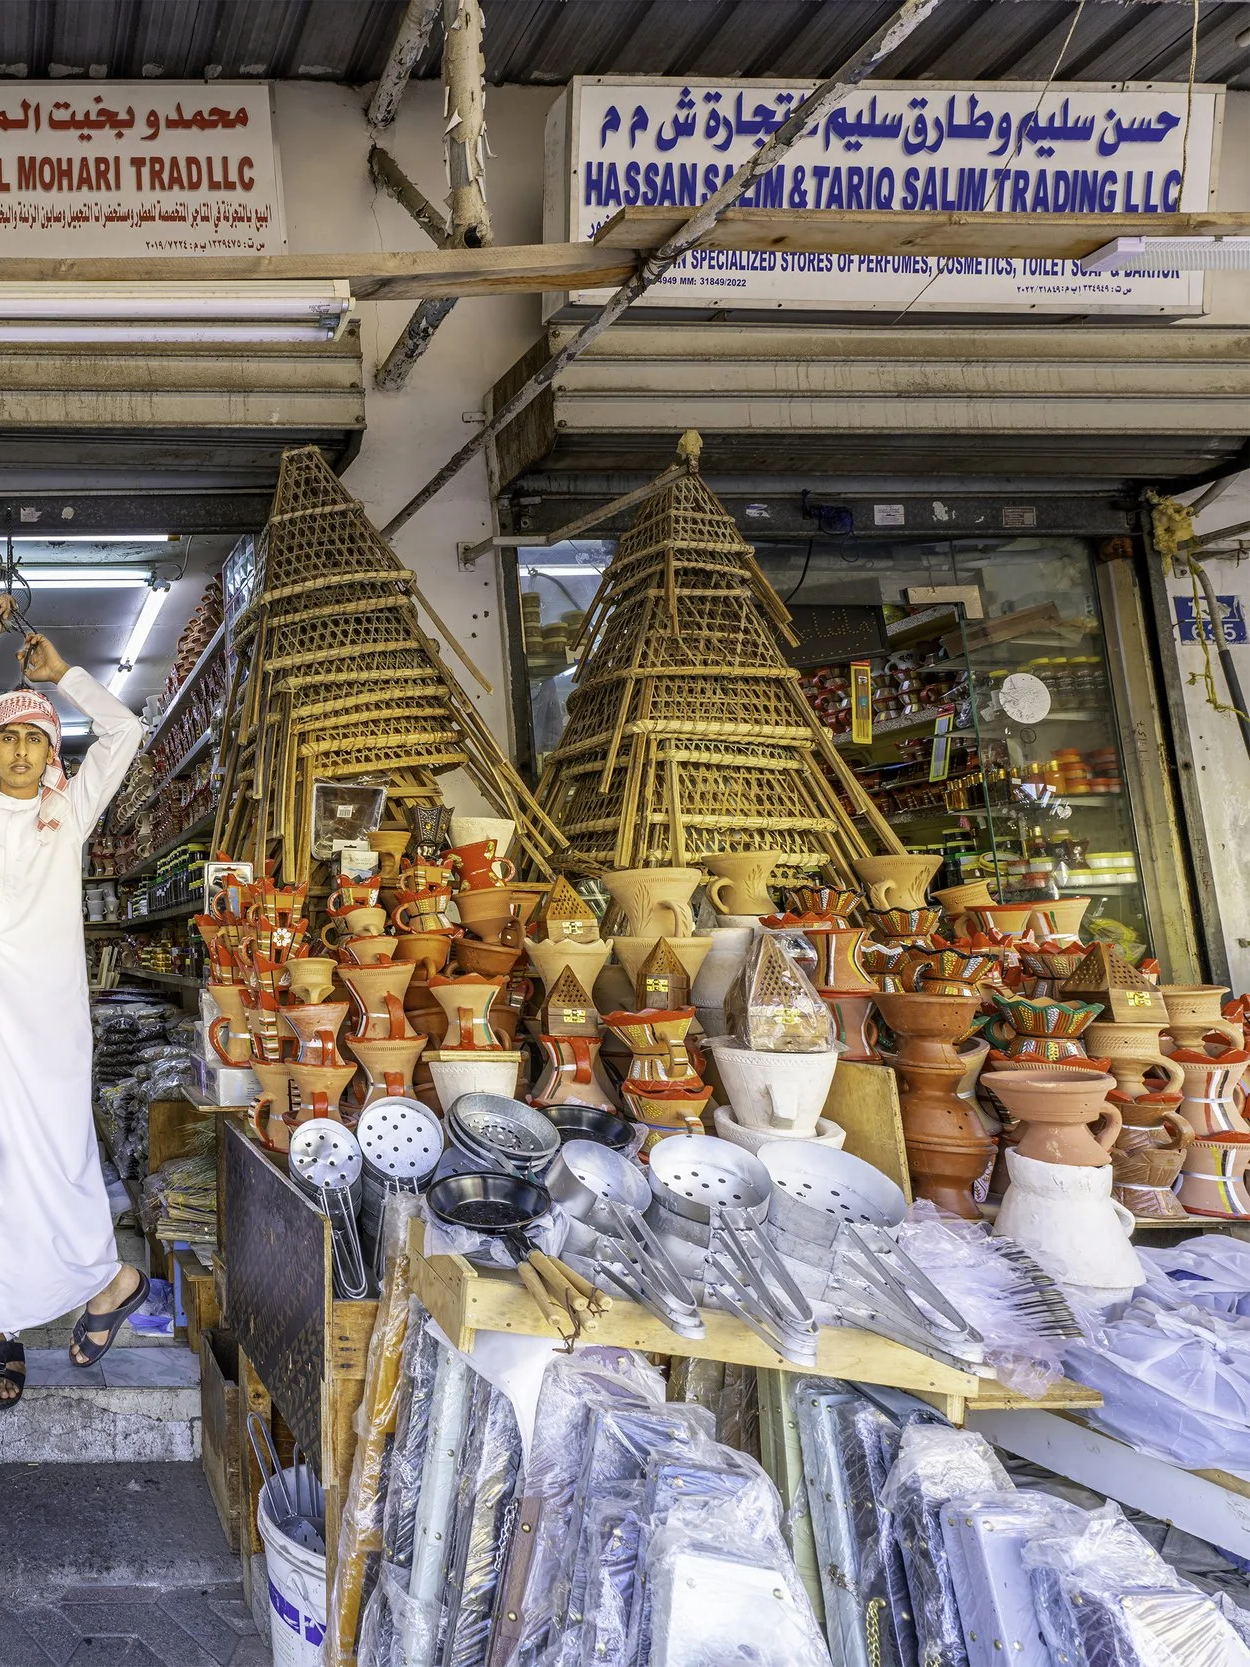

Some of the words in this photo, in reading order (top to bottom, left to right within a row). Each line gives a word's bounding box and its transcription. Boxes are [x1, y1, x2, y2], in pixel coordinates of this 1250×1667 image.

[49, 95, 136, 142] بخيت
[141, 109, 161, 141] و
[165, 102, 249, 131] محمد
[601, 104, 622, 149] م
[630, 104, 649, 149] م
[656, 86, 697, 152] ش
[825, 94, 904, 153] سليم
[1016, 97, 1096, 158] سليم
[1097, 107, 1182, 158] حسن
[17, 156, 121, 192] MOHARI
[585, 161, 698, 207] HASSAN
[789, 165, 808, 209] &
[813, 165, 896, 211] TARIQ
[902, 167, 988, 212] SALIM
[994, 168, 1118, 213] TRADING
[679, 278, 697, 286] MM:
[699, 278, 747, 287] 31849/2022
[690, 249, 776, 272] SPECIALIZED
[780, 251, 833, 273] STORES
[838, 253, 854, 273] OF
[858, 254, 932, 277] PERFUMES,
[936, 256, 1017, 279] COSMETICS,
[1022, 258, 1065, 277] TOILET
